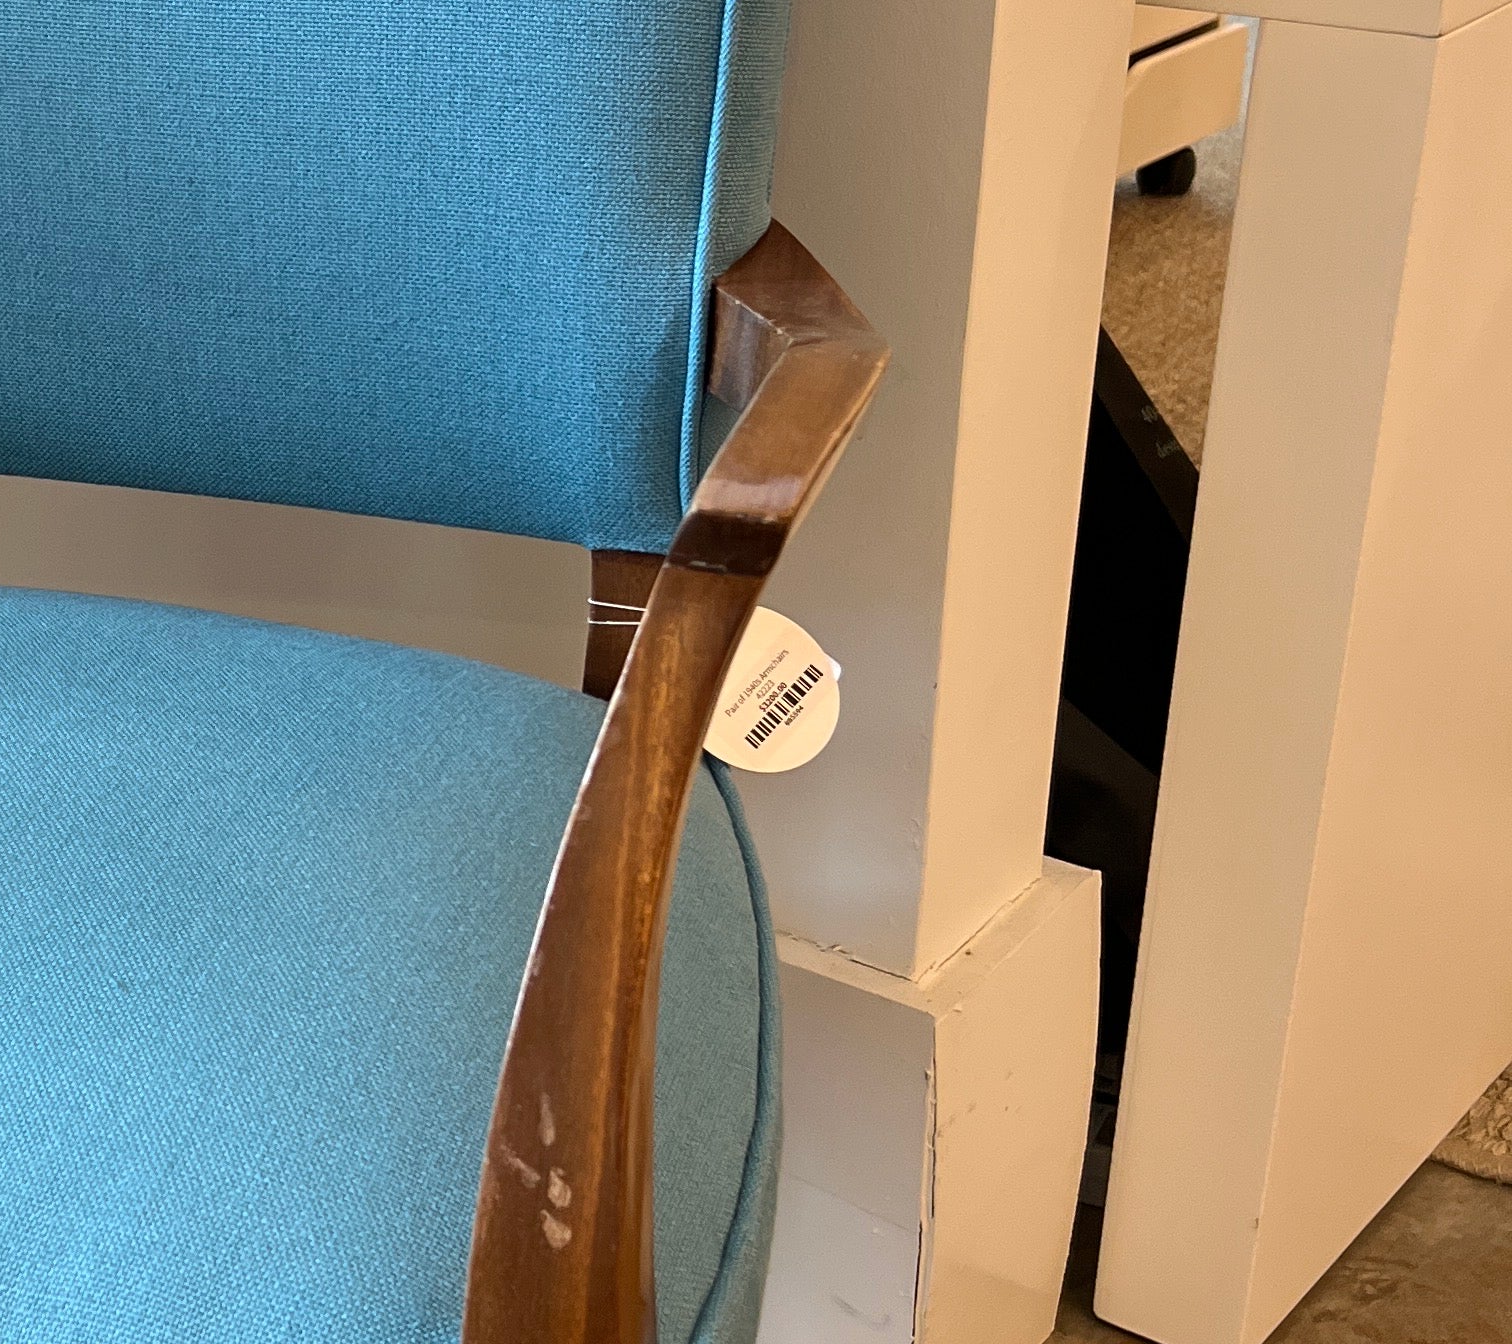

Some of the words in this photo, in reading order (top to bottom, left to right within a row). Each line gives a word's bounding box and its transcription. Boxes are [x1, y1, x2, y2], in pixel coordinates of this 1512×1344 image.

[724, 702, 739, 717] Pair
[737, 694, 746, 705] of
[743, 678, 763, 697] 1940s
[759, 649, 789, 680] Armchairs
